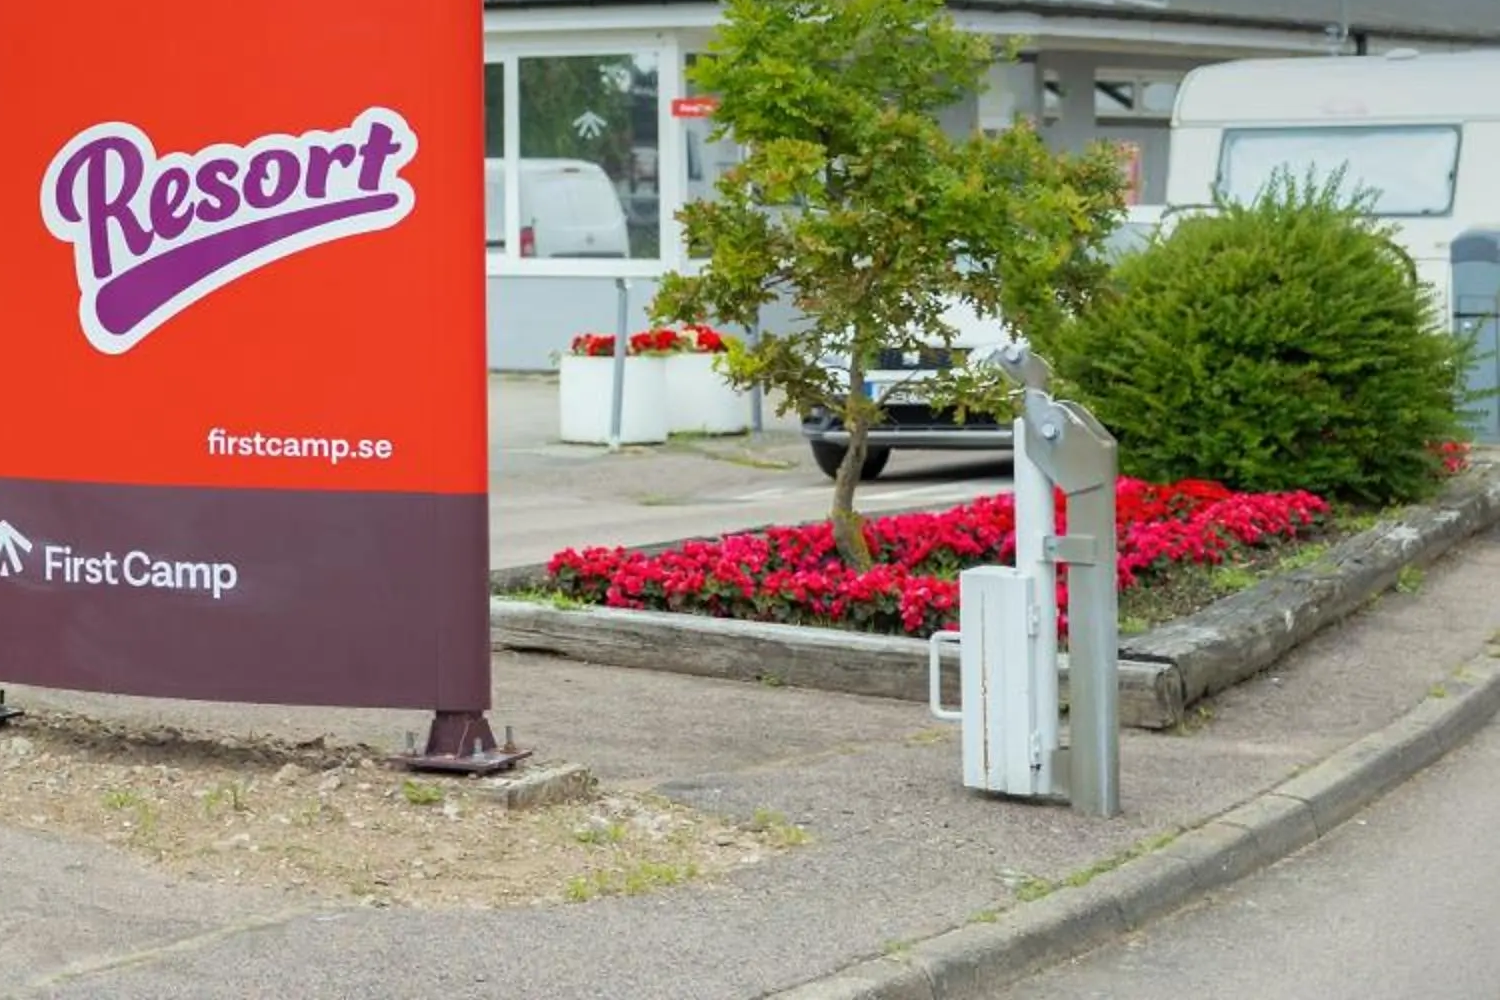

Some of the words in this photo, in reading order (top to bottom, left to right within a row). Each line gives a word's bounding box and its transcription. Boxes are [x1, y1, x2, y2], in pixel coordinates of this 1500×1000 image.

[54, 121, 402, 280] Resort
[207, 427, 394, 466] firstcamp.se
[44, 545, 119, 585] First
[122, 550, 238, 600] Camp
